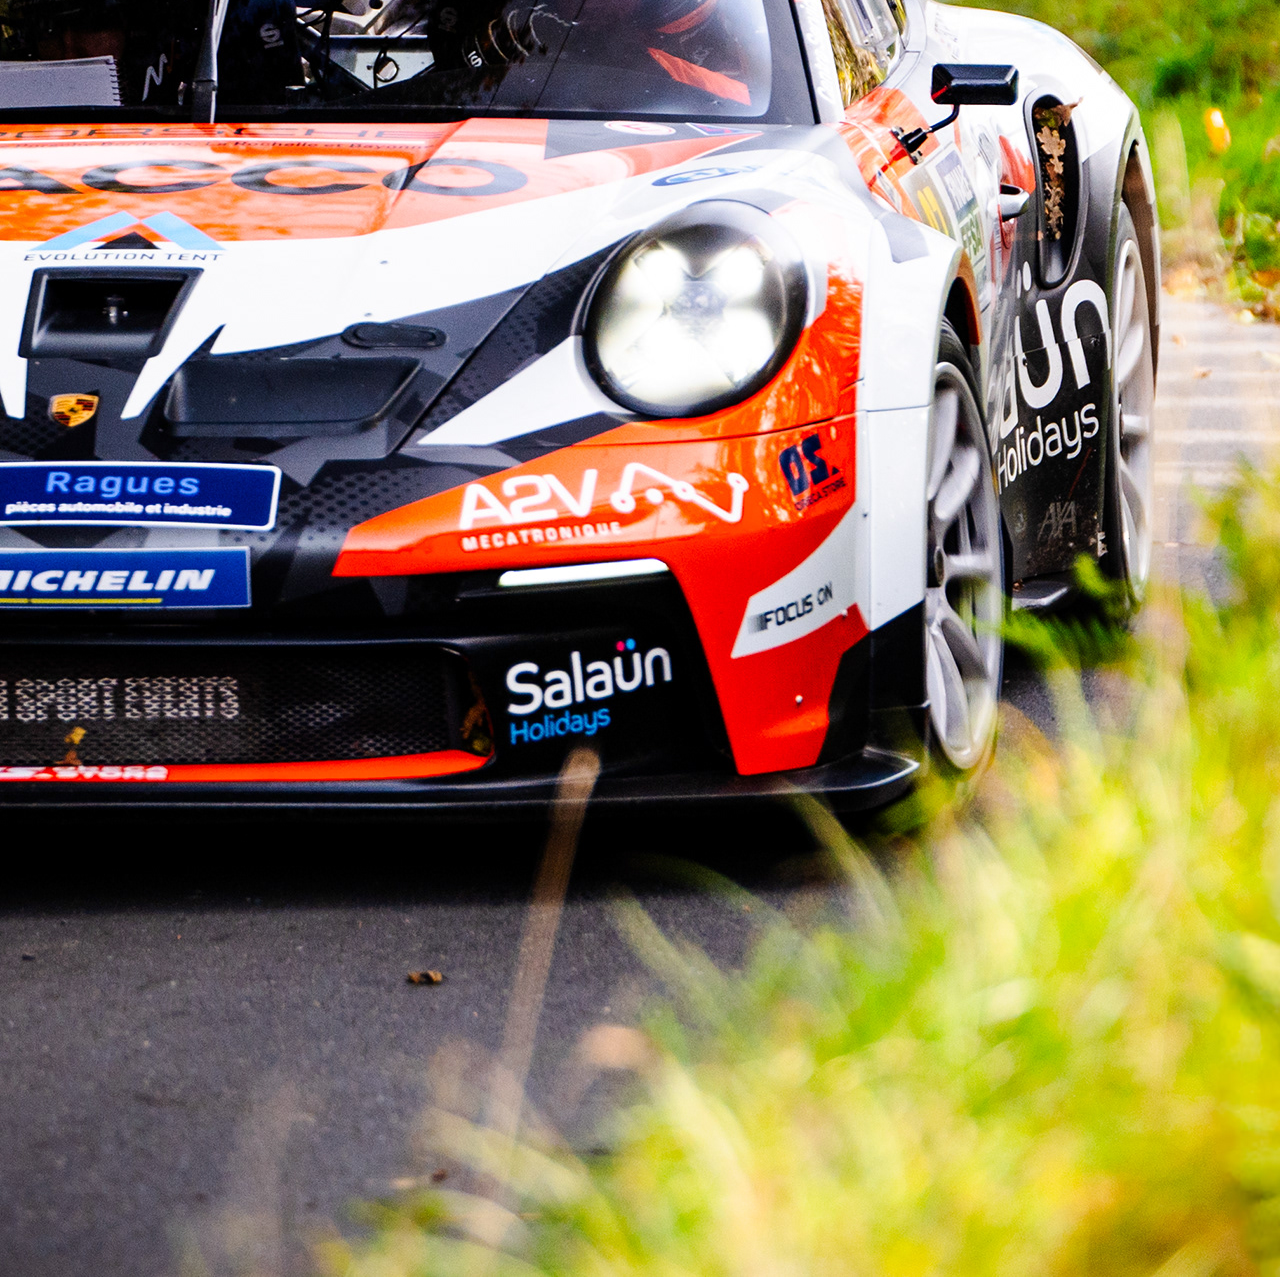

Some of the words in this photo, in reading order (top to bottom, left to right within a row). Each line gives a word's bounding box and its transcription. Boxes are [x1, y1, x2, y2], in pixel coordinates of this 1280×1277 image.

[24, 253, 156, 262] EVOLUTION
[166, 253, 226, 262] TENT
[998, 403, 1100, 495] Holidays
[46, 471, 201, 498] Ragues
[459, 468, 598, 530] A2V
[5, 501, 57, 515] pièces
[57, 501, 144, 514] automobile
[144, 503, 162, 514] et
[163, 503, 233, 517] industrie
[461, 522, 622, 552] MECATRONIQUE
[763, 594, 814, 628] FOCUS
[816, 581, 835, 607] ON
[505, 638, 672, 715] Salaün
[509, 707, 611, 745] Holidays
